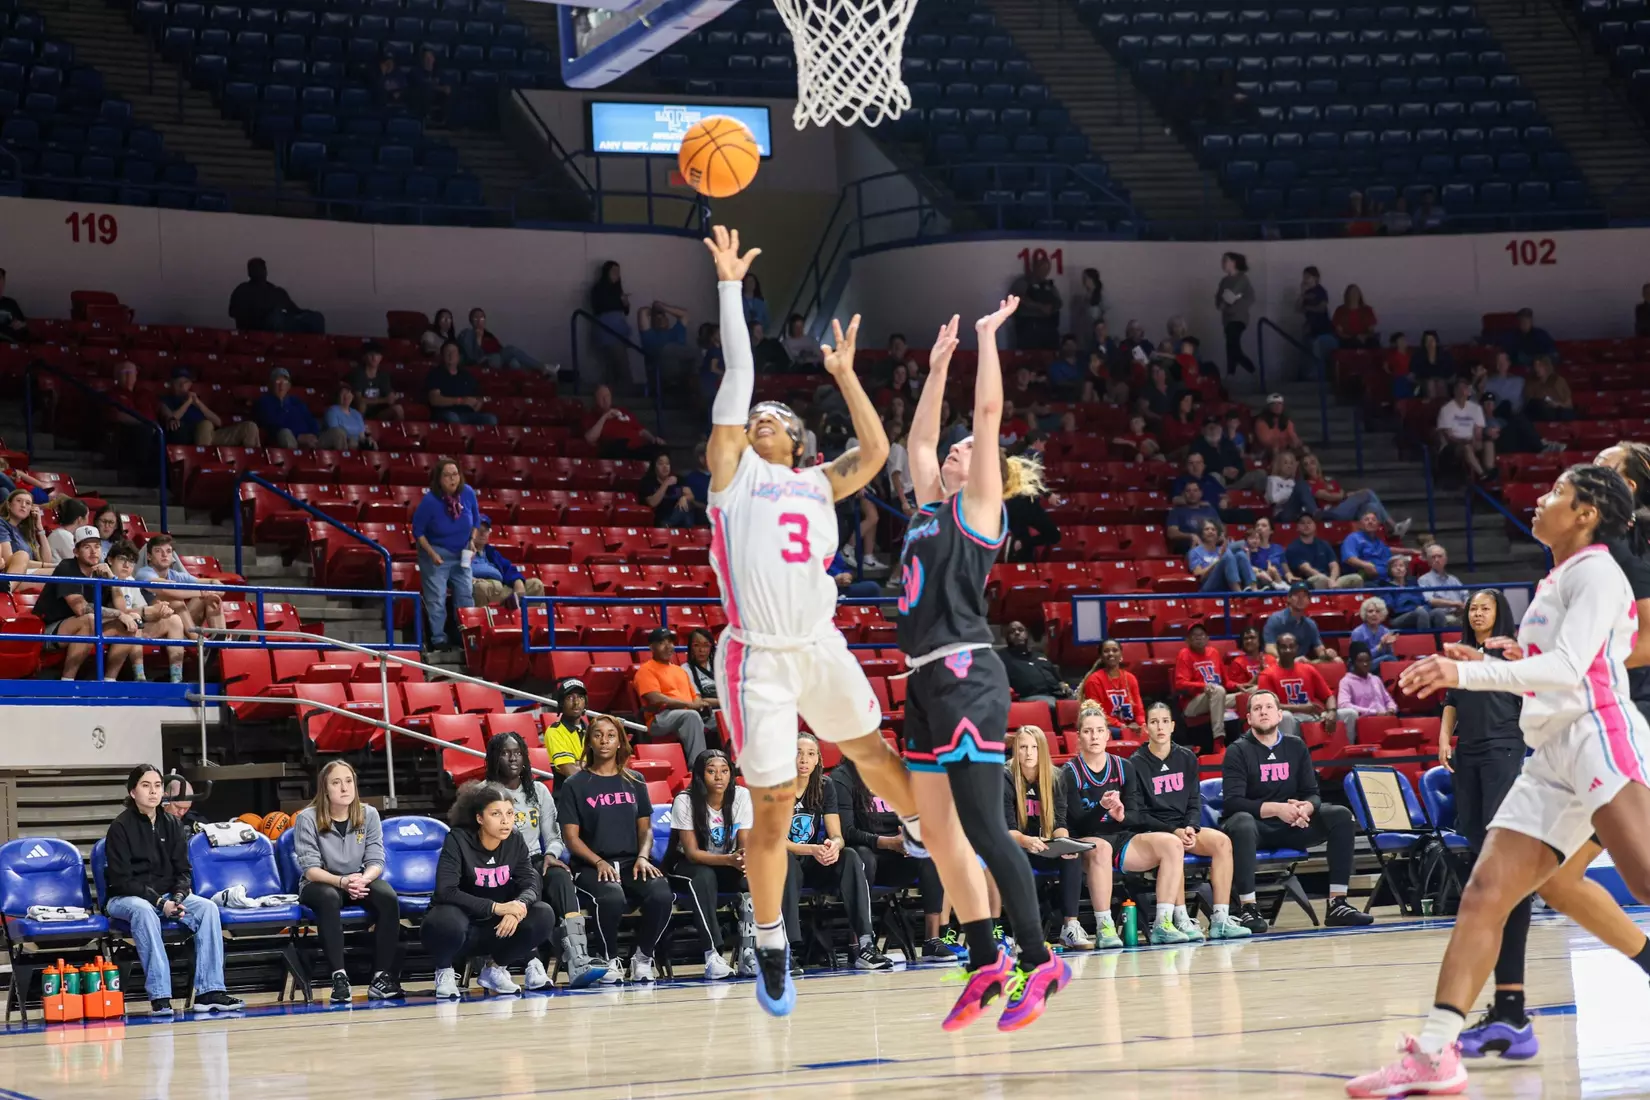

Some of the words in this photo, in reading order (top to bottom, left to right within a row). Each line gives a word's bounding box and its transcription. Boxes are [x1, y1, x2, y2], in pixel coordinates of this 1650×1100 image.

[65, 211, 118, 245] 119
[1505, 238, 1557, 266] 102
[778, 512, 811, 563] 3
[1152, 772, 1184, 795] FIU
[1260, 762, 1290, 782] FIU
[528, 808, 539, 829] 5
[474, 865, 510, 888] FIU
